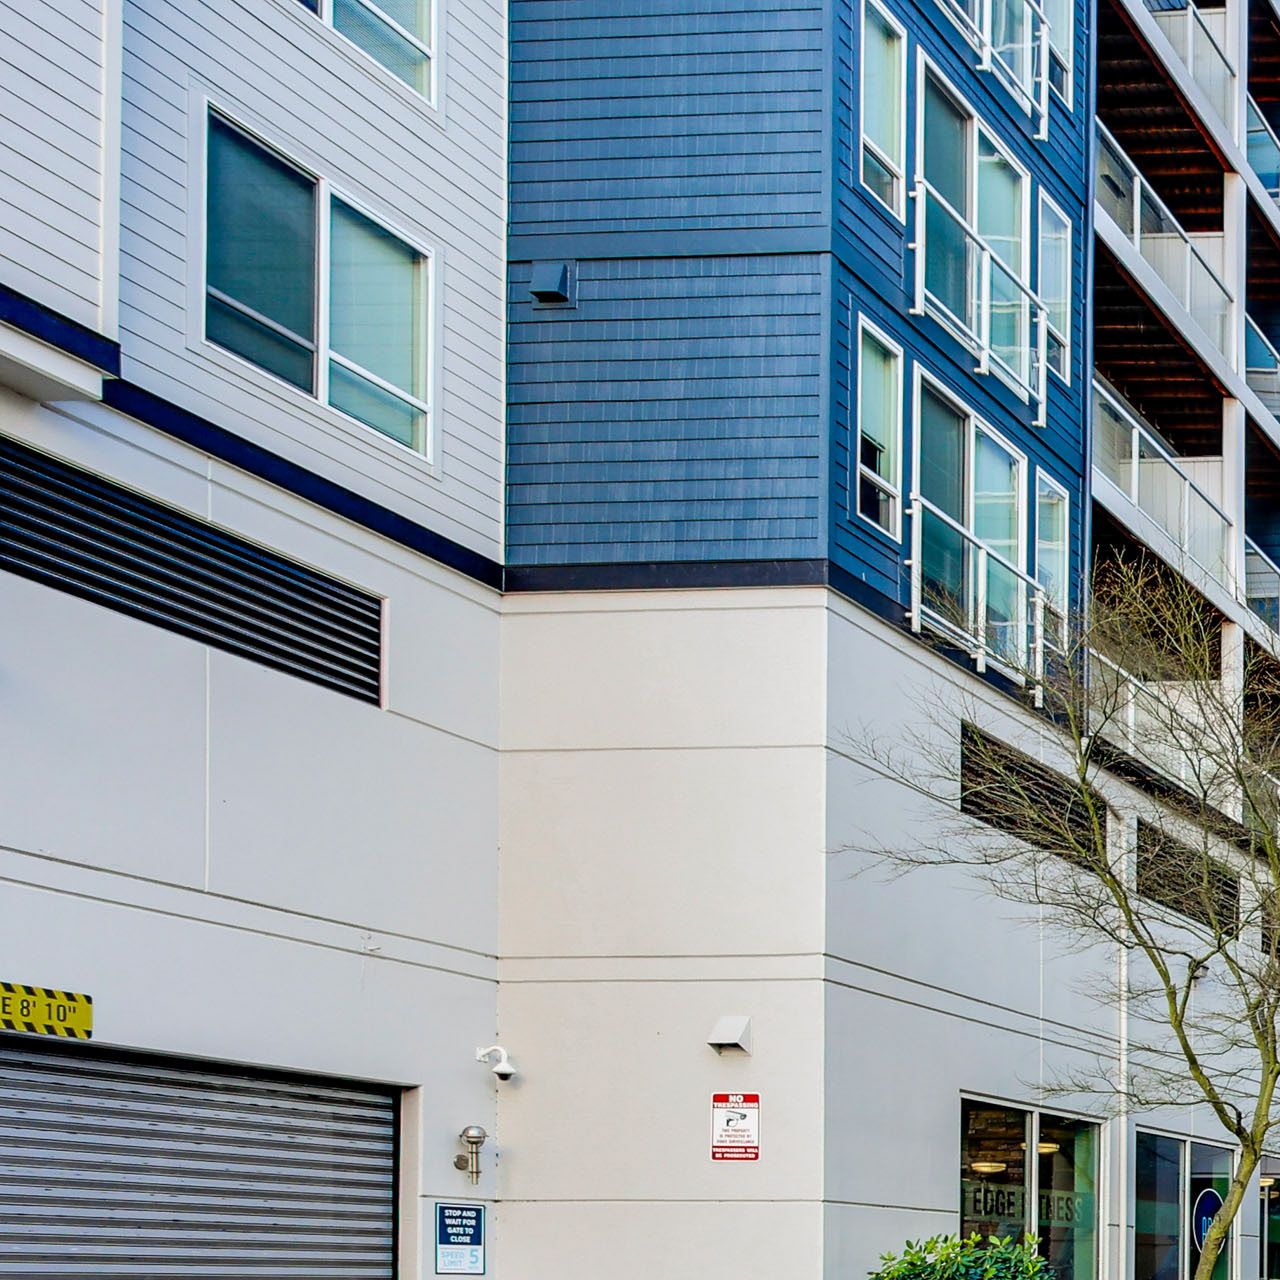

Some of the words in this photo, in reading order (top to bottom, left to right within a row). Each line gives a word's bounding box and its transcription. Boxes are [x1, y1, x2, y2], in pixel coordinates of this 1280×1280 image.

[973, 1188, 1016, 1217] EDGE
[444, 1209, 462, 1217] STOP
[450, 1235, 471, 1243] CLOSE
[470, 1248, 479, 1265] 5
